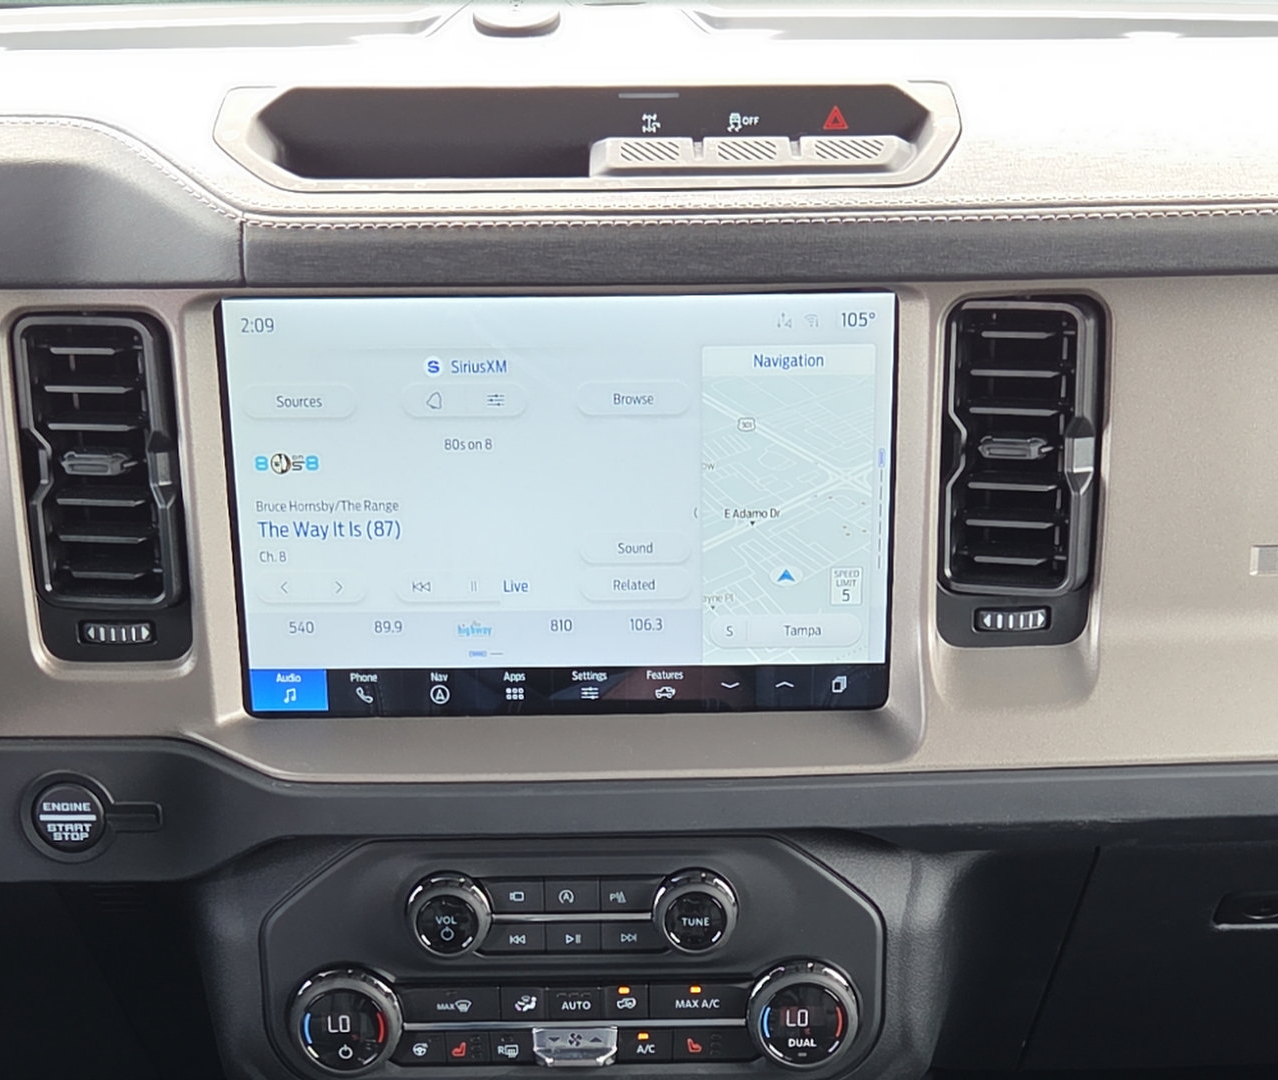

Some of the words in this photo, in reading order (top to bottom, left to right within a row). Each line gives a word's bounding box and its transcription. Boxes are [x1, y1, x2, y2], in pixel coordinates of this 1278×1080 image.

[742, 115, 760, 126] OFF
[240, 318, 275, 333] 2:09
[841, 312, 876, 327] 105°
[450, 359, 508, 374] SiriusXM
[753, 354, 824, 370] Navigation
[276, 395, 323, 408] Sources
[613, 393, 654, 405] Browse
[444, 439, 466, 450] 80s
[468, 441, 482, 450] on
[485, 439, 493, 450] 8
[256, 501, 287, 512] Bruce
[289, 500, 362, 513] Hornsby/The
[364, 500, 399, 513] Range
[724, 509, 730, 518] E
[733, 509, 768, 519] Adamo
[770, 508, 780, 518] Dr
[257, 521, 289, 537] The
[292, 521, 329, 540] Way
[333, 521, 344, 537] It
[349, 521, 362, 537] Is
[366, 520, 401, 540] (87)
[618, 542, 653, 554] Sound
[259, 551, 277, 562] Ch.
[279, 551, 287, 562] 8
[834, 570, 860, 578] SPEED
[503, 580, 528, 592] Live
[613, 579, 656, 591] Related
[842, 589, 850, 602] 5
[289, 621, 315, 634] 540
[374, 620, 403, 634] 89.9
[550, 619, 572, 632] 810
[630, 618, 663, 631] 106.3
[726, 626, 733, 637] S
[784, 625, 821, 637] Tampa
[276, 673, 301, 683] Audio
[350, 672, 378, 683] Phone
[431, 672, 448, 682] Nav
[503, 671, 526, 683] Apps
[571, 670, 607, 682] Settings
[646, 670, 683, 680] Features
[43, 802, 91, 812] ENGINE
[47, 823, 92, 832] START
[53, 832, 89, 841] STOP
[435, 915, 457, 926] VOL
[681, 916, 710, 927] TUNE
[437, 1003, 455, 1011] MAX
[561, 1001, 591, 1011] AUTO
[675, 999, 699, 1009] MAX
[701, 999, 720, 1009] A/C
[327, 1015, 351, 1033] LO
[786, 1009, 808, 1027] LO
[788, 1038, 817, 1048] DUAL
[637, 1044, 655, 1055] A/C
